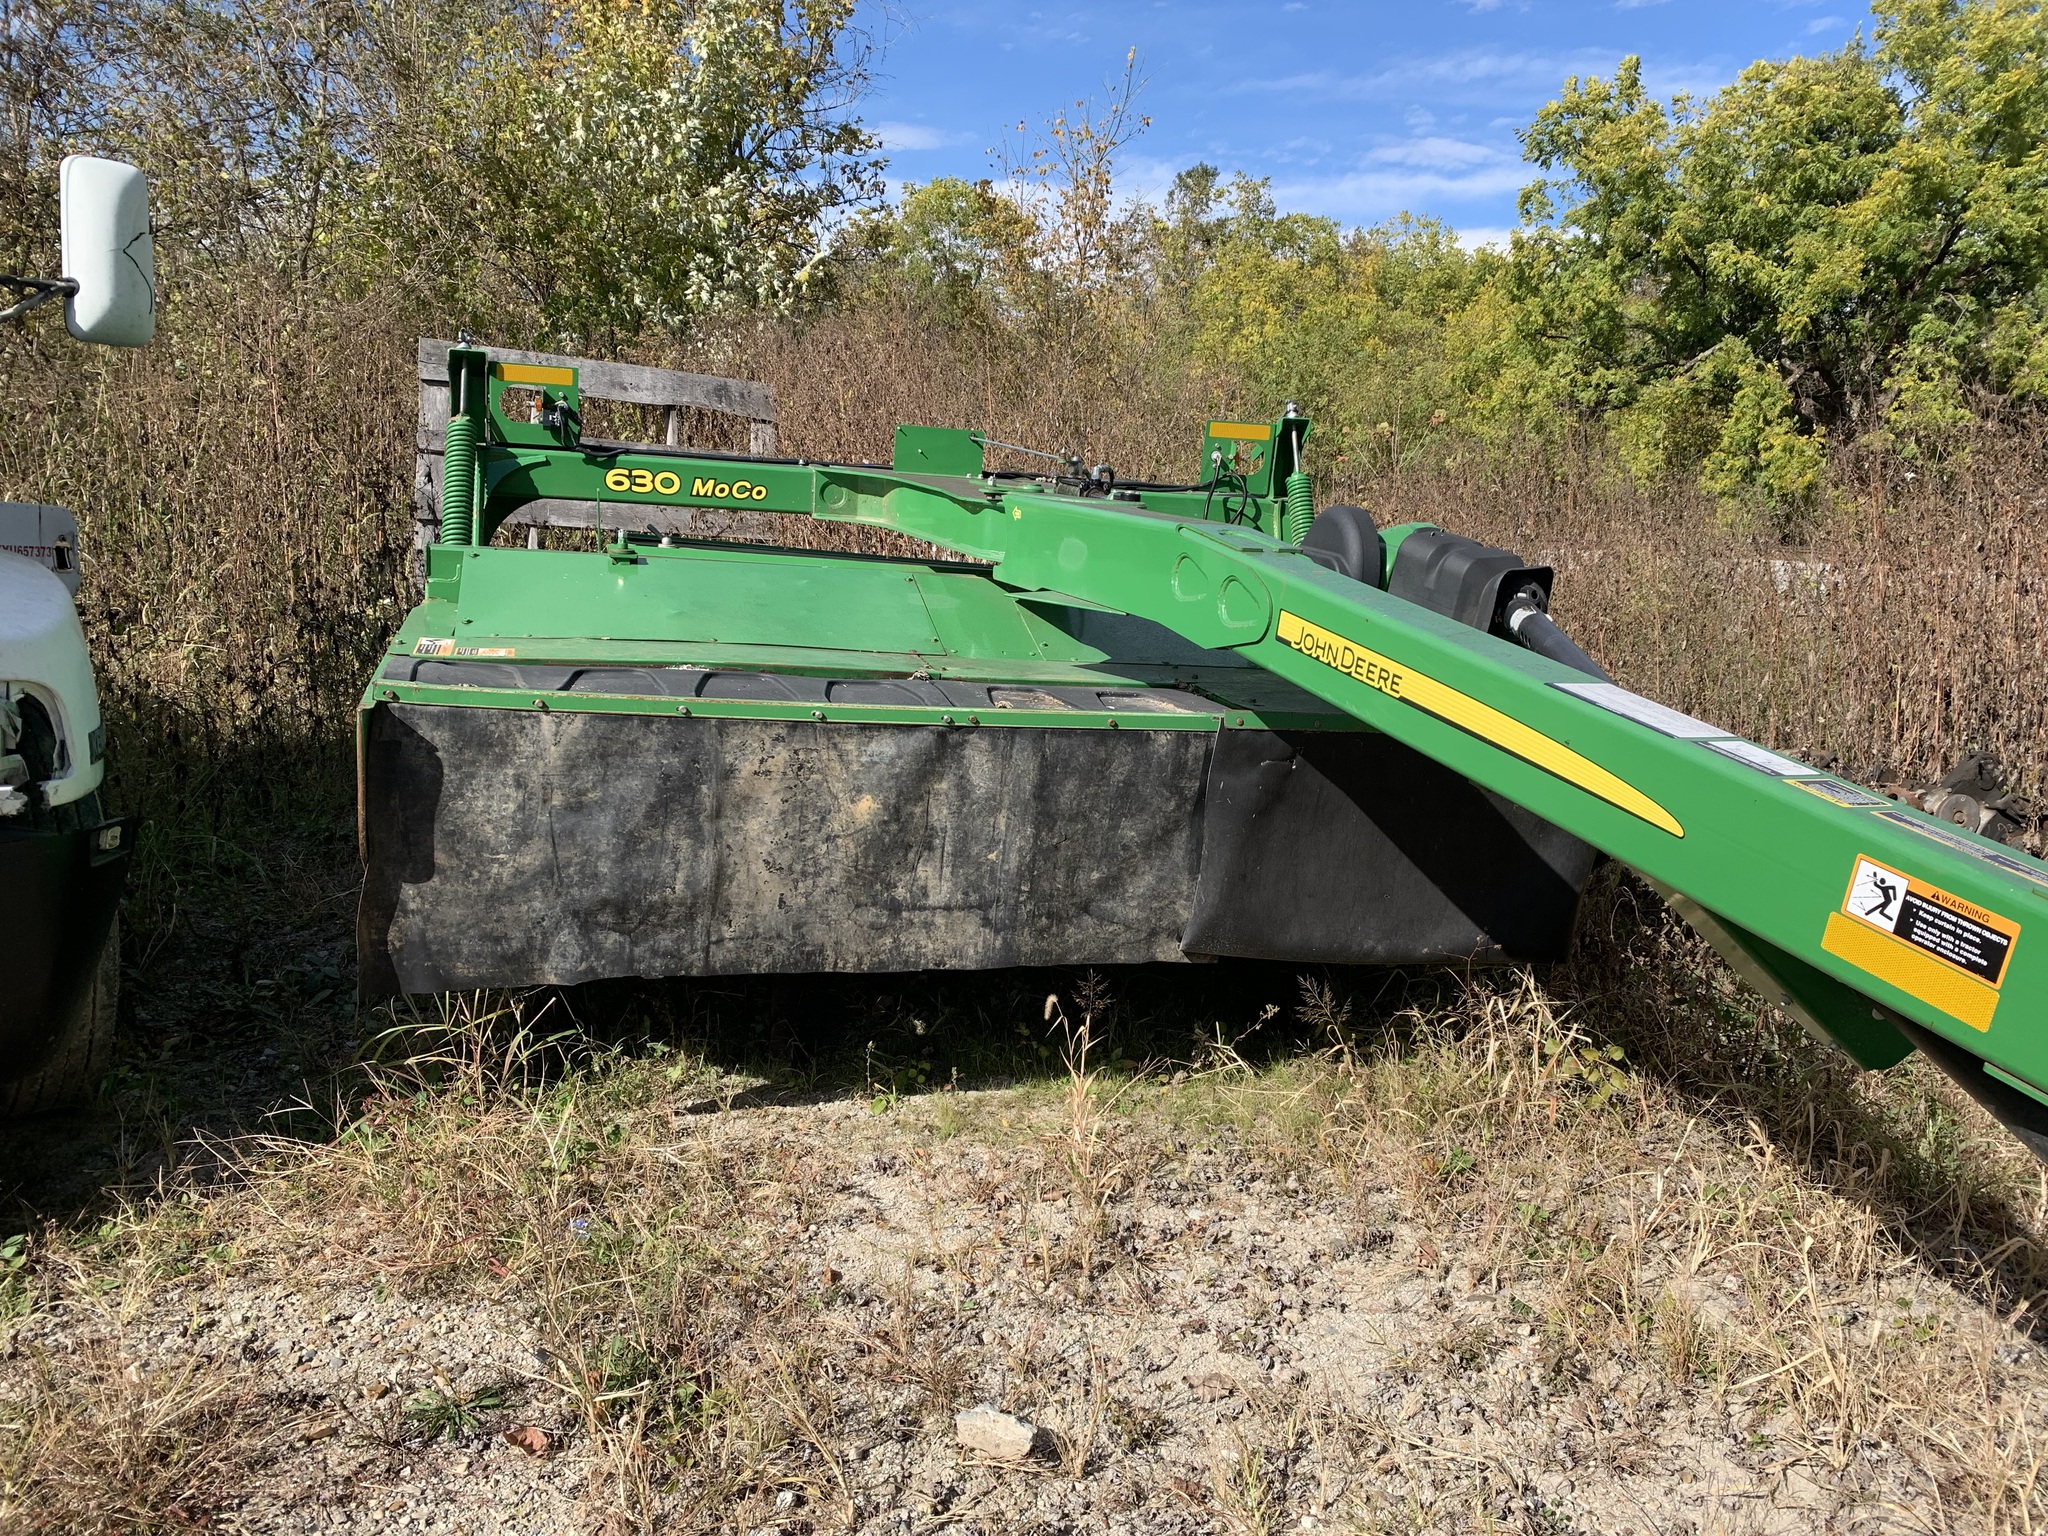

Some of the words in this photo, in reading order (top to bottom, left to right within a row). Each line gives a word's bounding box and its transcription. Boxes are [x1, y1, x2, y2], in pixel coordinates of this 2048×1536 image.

[604, 467, 681, 495] 630
[690, 476, 768, 501] MoCo
[1293, 626, 1339, 664] JOHN
[1340, 645, 1403, 694] DEERE
[1905, 895, 1922, 907] AVOID
[1922, 901, 1942, 915] INJURY
[1941, 909, 1958, 922] FROM
[1957, 917, 1982, 933] THROWN
[1981, 929, 2009, 946] OBJECTS
[1941, 894, 1991, 923] WARNING
[1915, 919, 1927, 930] Use
[1927, 924, 1941, 937] only
[1941, 931, 1955, 943] with
[1960, 940, 1982, 955] tractor
[1918, 910, 1934, 922] Keep
[1934, 918, 1956, 932] curtain
[1956, 926, 1963, 935] in
[1962, 931, 1982, 944] place.
[1911, 934, 1936, 949] operator
[1936, 944, 1968, 965] enclosure.
[1913, 927, 1941, 944] equipped
[1940, 938, 1954, 950] with
[1959, 949, 1988, 966] complete
